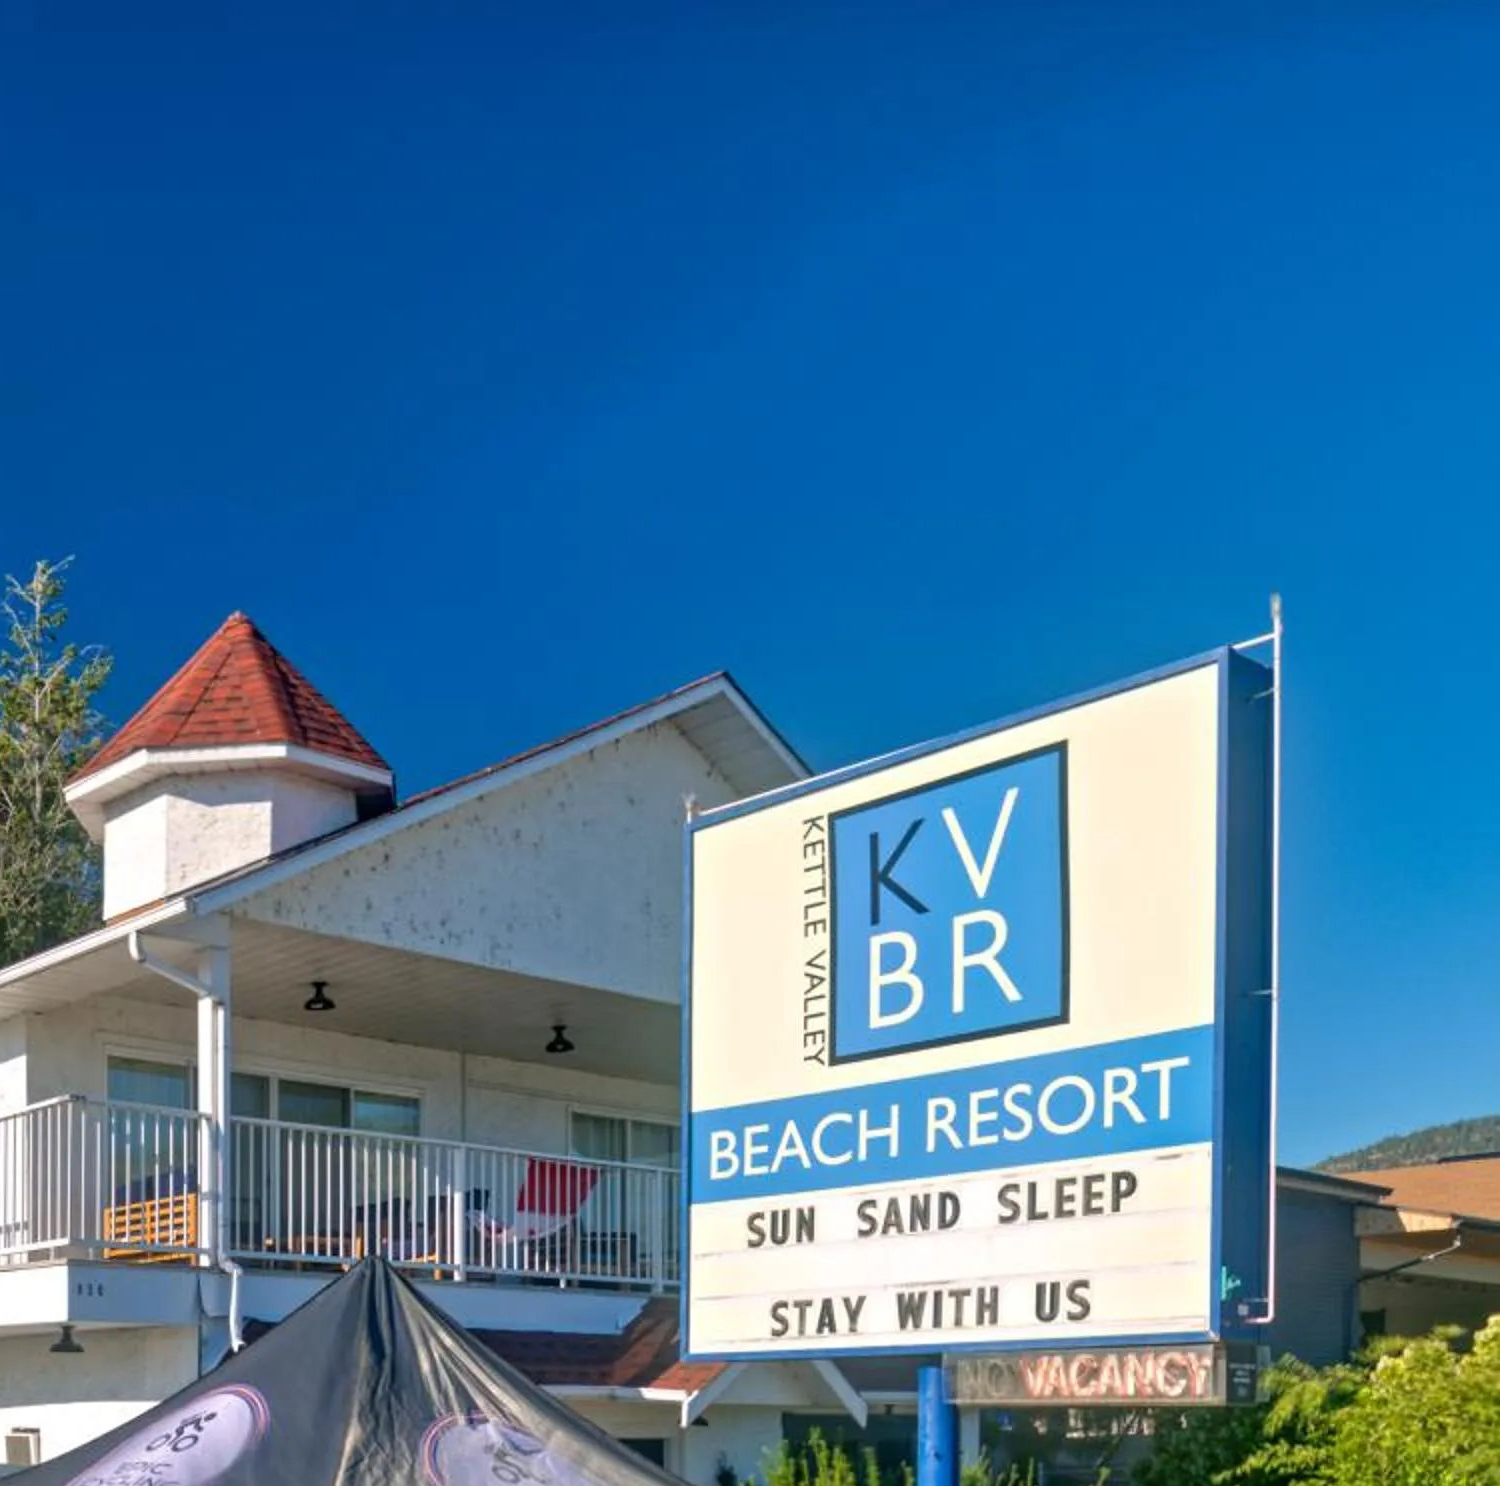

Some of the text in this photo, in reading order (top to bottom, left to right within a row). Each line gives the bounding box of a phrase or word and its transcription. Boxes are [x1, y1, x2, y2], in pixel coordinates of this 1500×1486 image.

[802, 815, 827, 1067] KETTLE VALLEY
[710, 1057, 1190, 1180] BEACH RESORT
[746, 1170, 1138, 1249] SUN SAND SLEEP
[770, 1279, 1092, 1337] STAY WITH US
[957, 1358, 1015, 1397] NO
[1020, 1351, 1212, 1397] VACANCY
